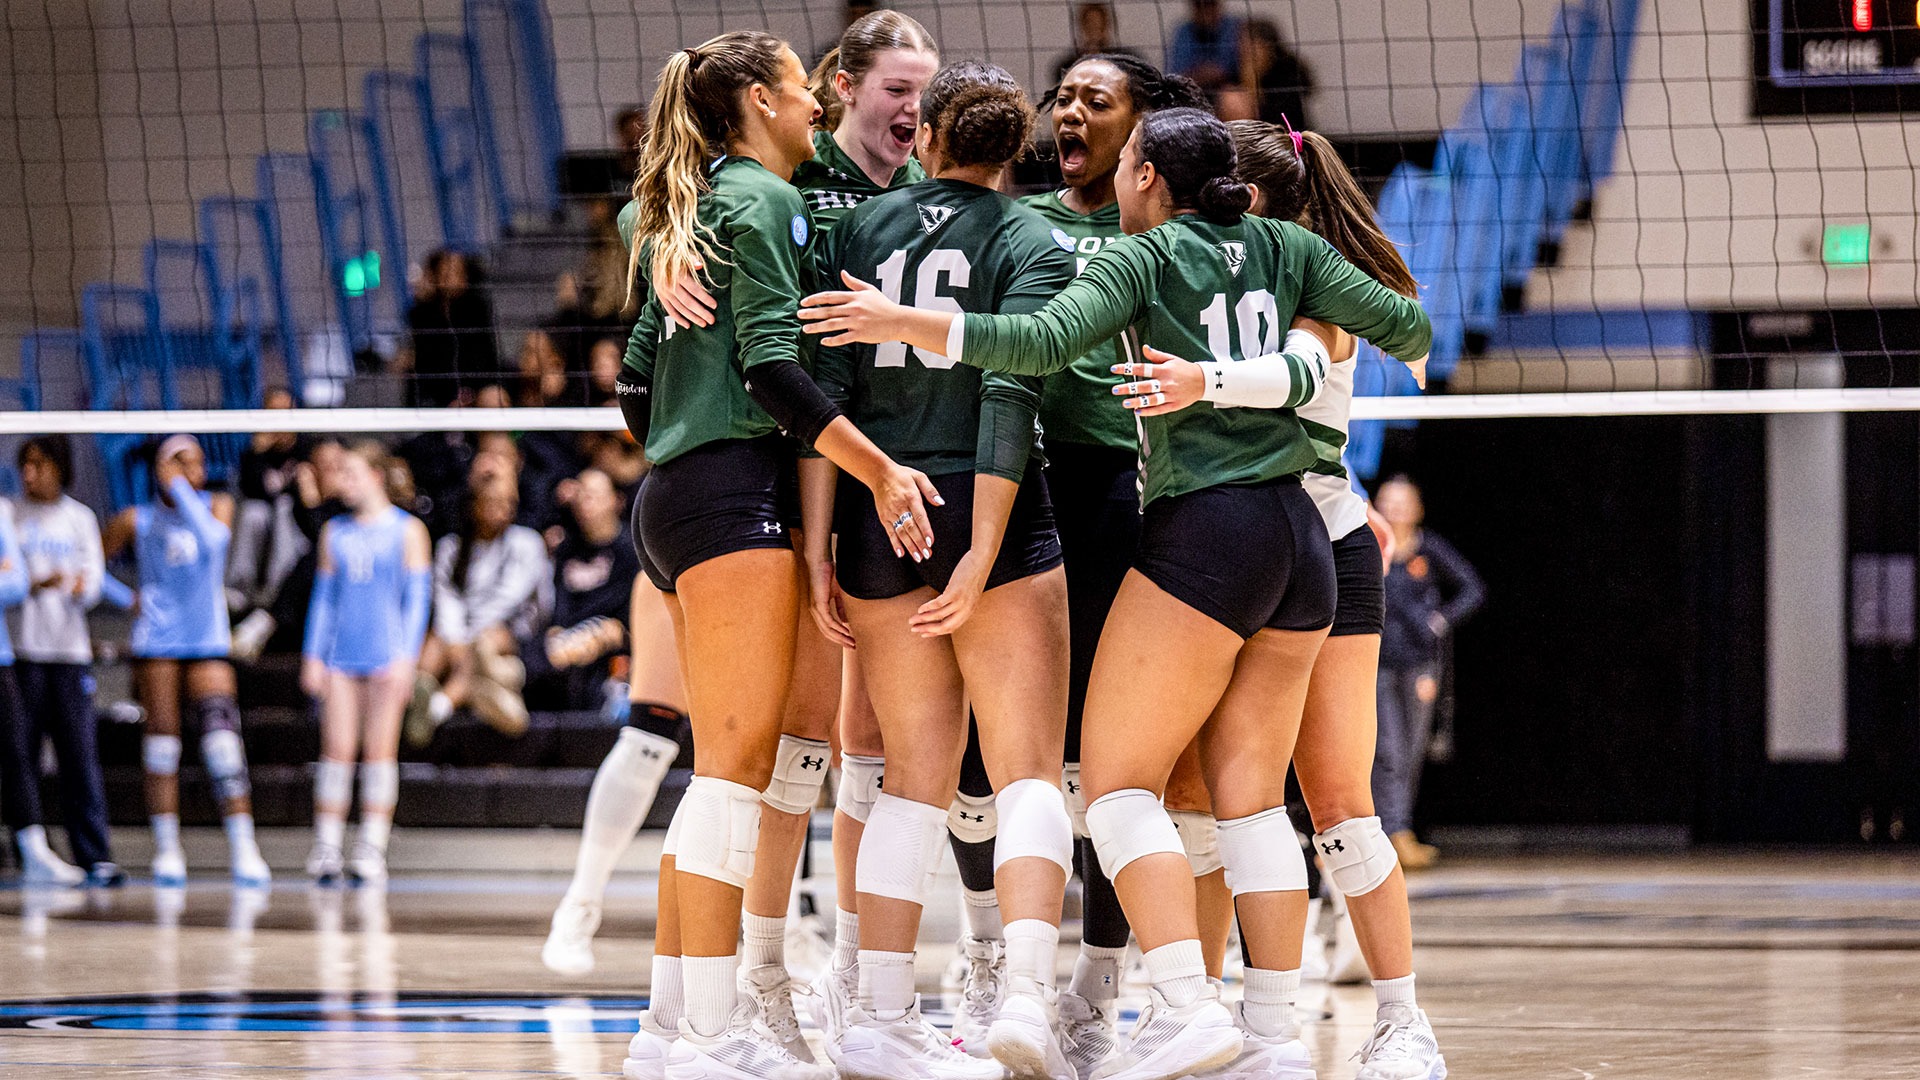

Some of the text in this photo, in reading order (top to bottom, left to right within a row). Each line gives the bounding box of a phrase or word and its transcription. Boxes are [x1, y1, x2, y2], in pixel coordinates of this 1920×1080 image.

[1803, 39, 1881, 75] SCORE
[874, 248, 971, 370] 16
[1199, 288, 1280, 362] 10
